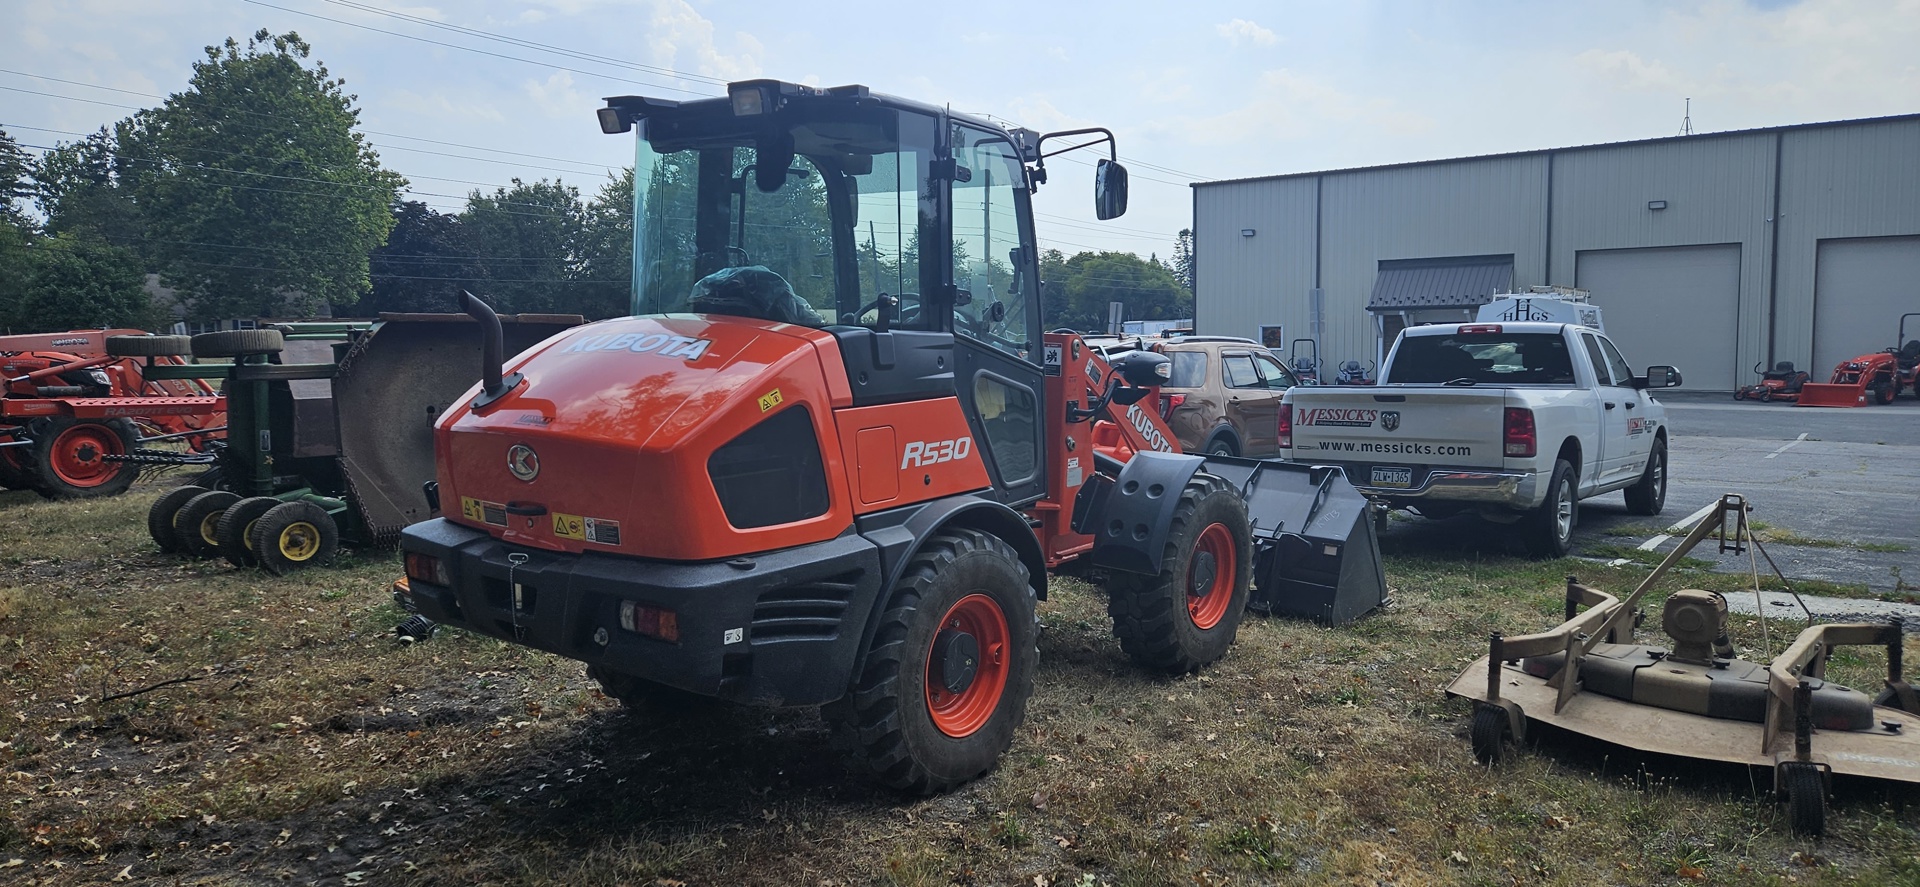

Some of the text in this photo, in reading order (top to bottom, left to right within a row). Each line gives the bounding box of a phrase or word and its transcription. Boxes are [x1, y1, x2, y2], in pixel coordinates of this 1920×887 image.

[561, 333, 712, 361] KUBOTA
[1295, 408, 1378, 427] MESSICK'S
[901, 437, 971, 470] R530
[1319, 441, 1471, 456] www.messicks.com
